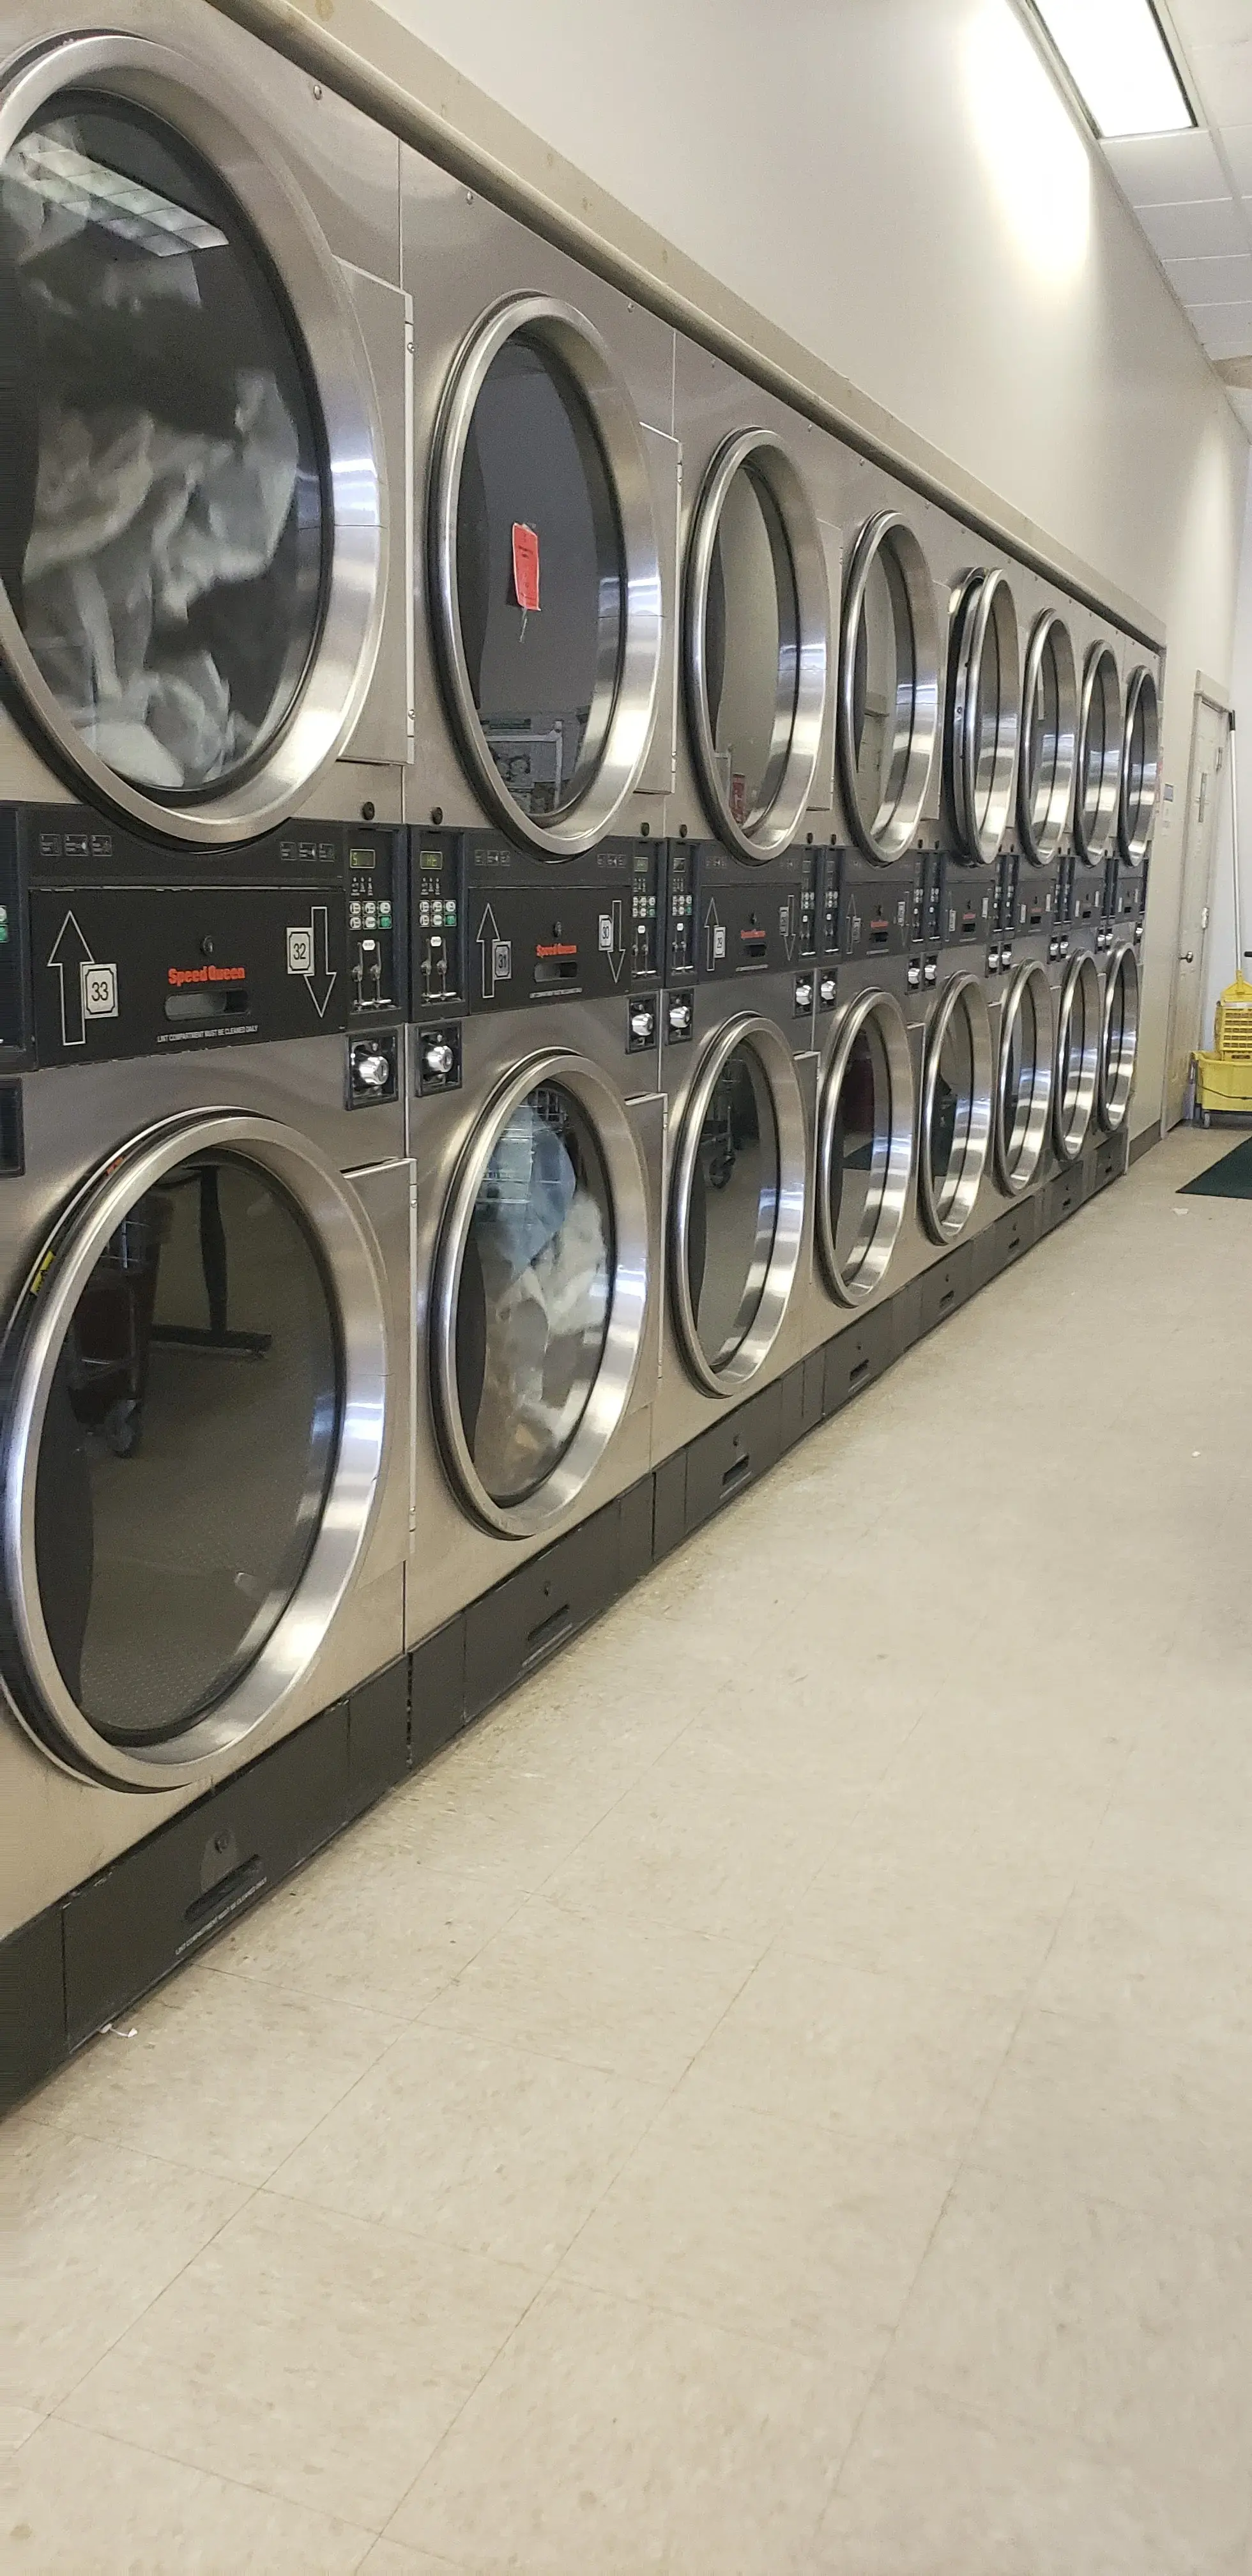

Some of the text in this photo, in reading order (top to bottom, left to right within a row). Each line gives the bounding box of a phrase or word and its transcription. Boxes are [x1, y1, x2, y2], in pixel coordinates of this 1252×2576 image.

[293, 942, 307, 960] 32
[498, 953, 507, 969] 31
[169, 965, 245, 986] Speed Queen
[91, 981, 109, 1002] 33
